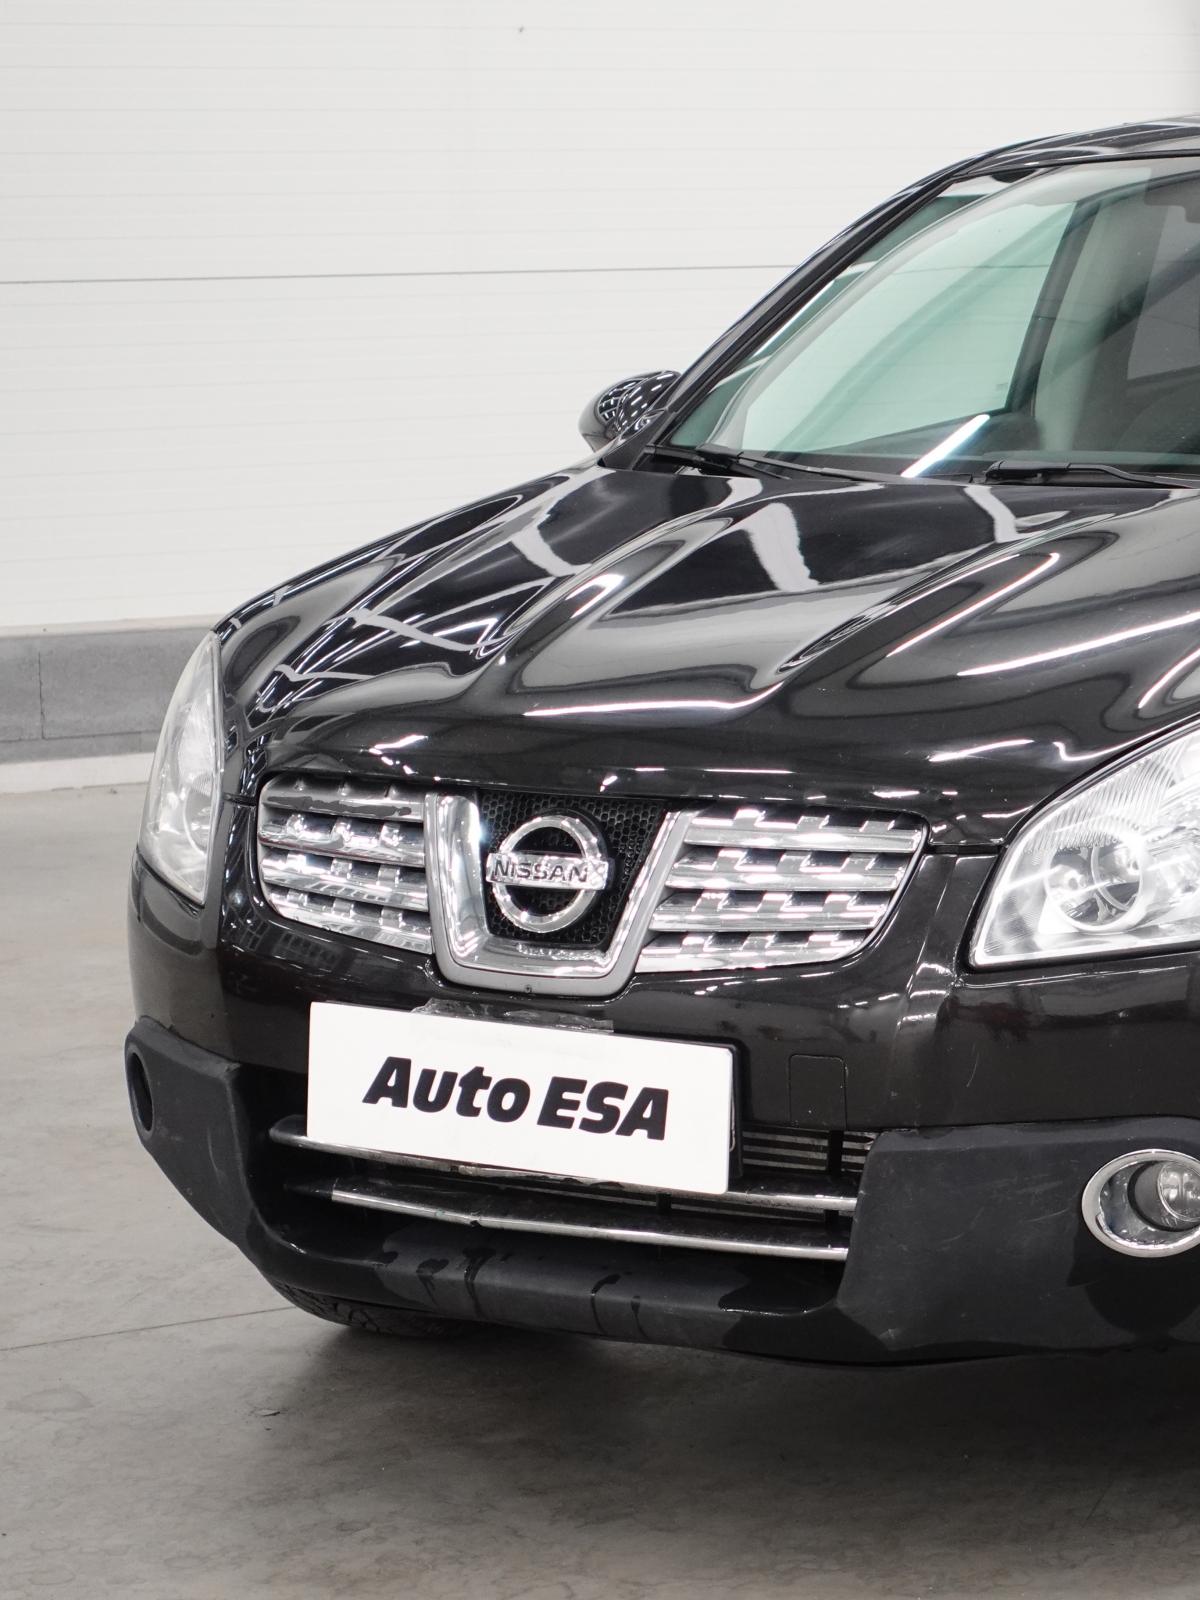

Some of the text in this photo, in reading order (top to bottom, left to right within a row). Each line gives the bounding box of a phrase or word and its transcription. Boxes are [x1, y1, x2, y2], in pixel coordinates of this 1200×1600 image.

[494, 859, 588, 882] NISSAN
[363, 1057, 669, 1141] Auto ESA
